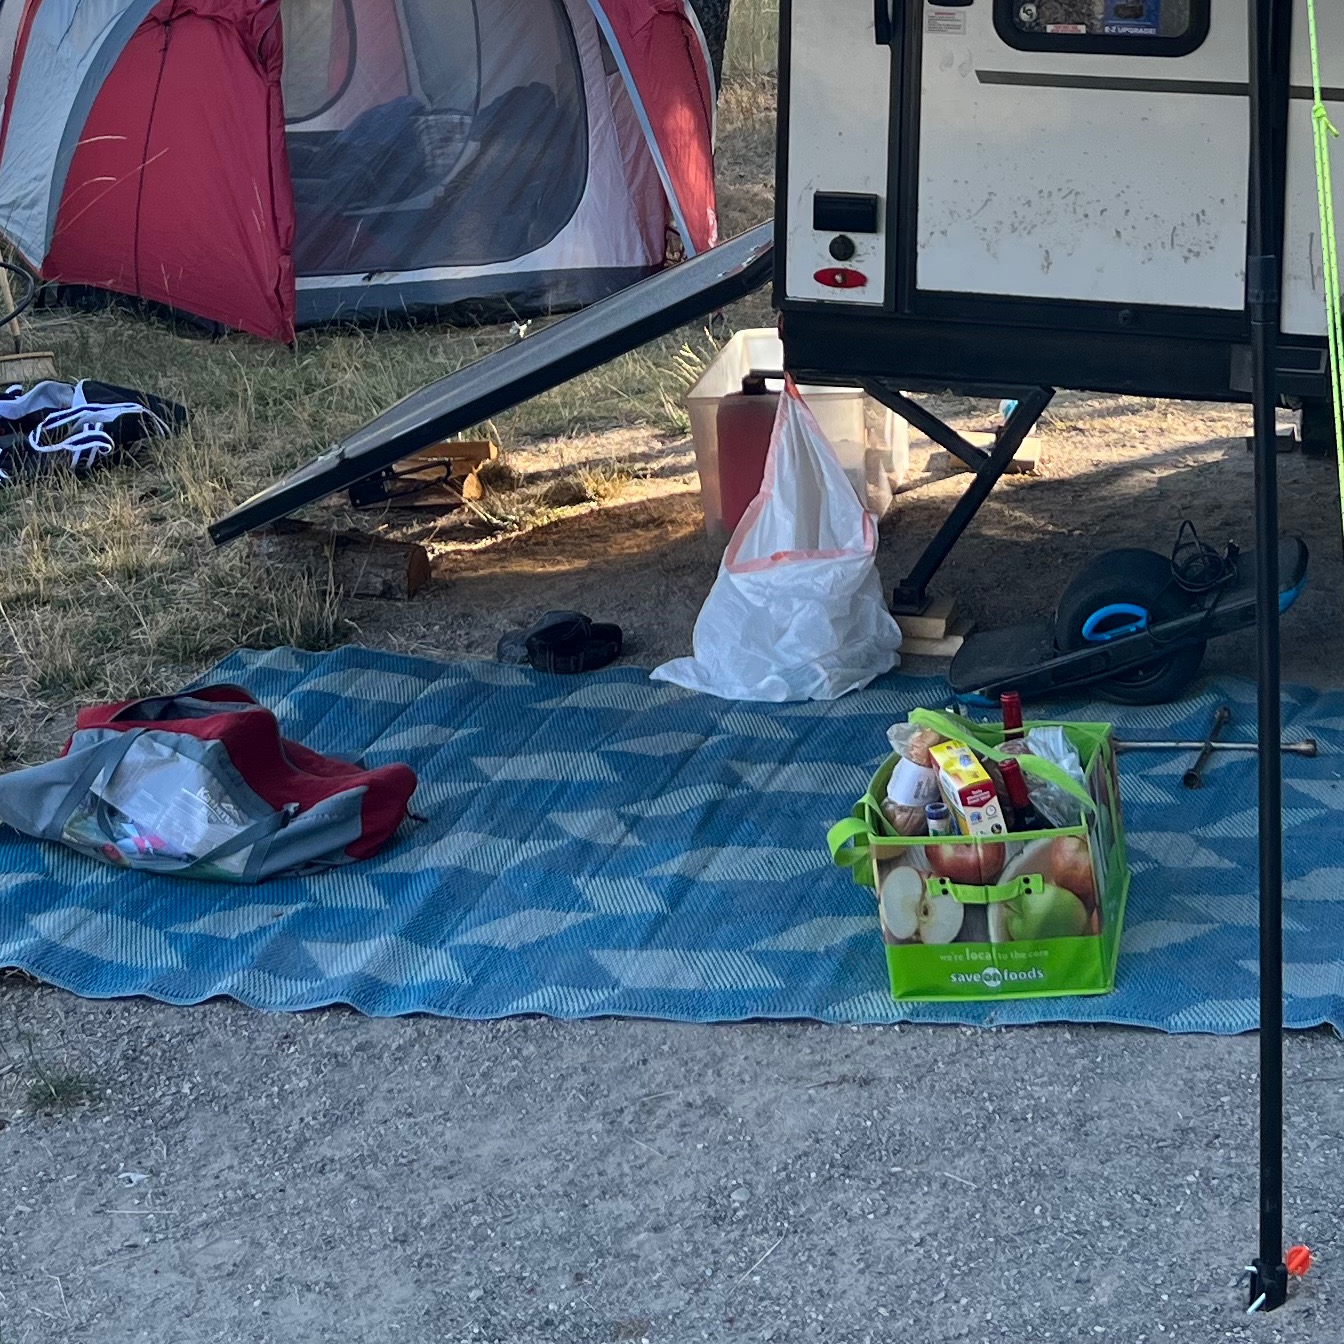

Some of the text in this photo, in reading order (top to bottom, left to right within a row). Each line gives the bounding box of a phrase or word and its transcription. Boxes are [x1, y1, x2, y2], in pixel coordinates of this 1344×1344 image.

[939, 951, 964, 962] we're
[966, 947, 997, 961] local
[1010, 950, 1027, 960] the
[950, 966, 1044, 983] save on foods
